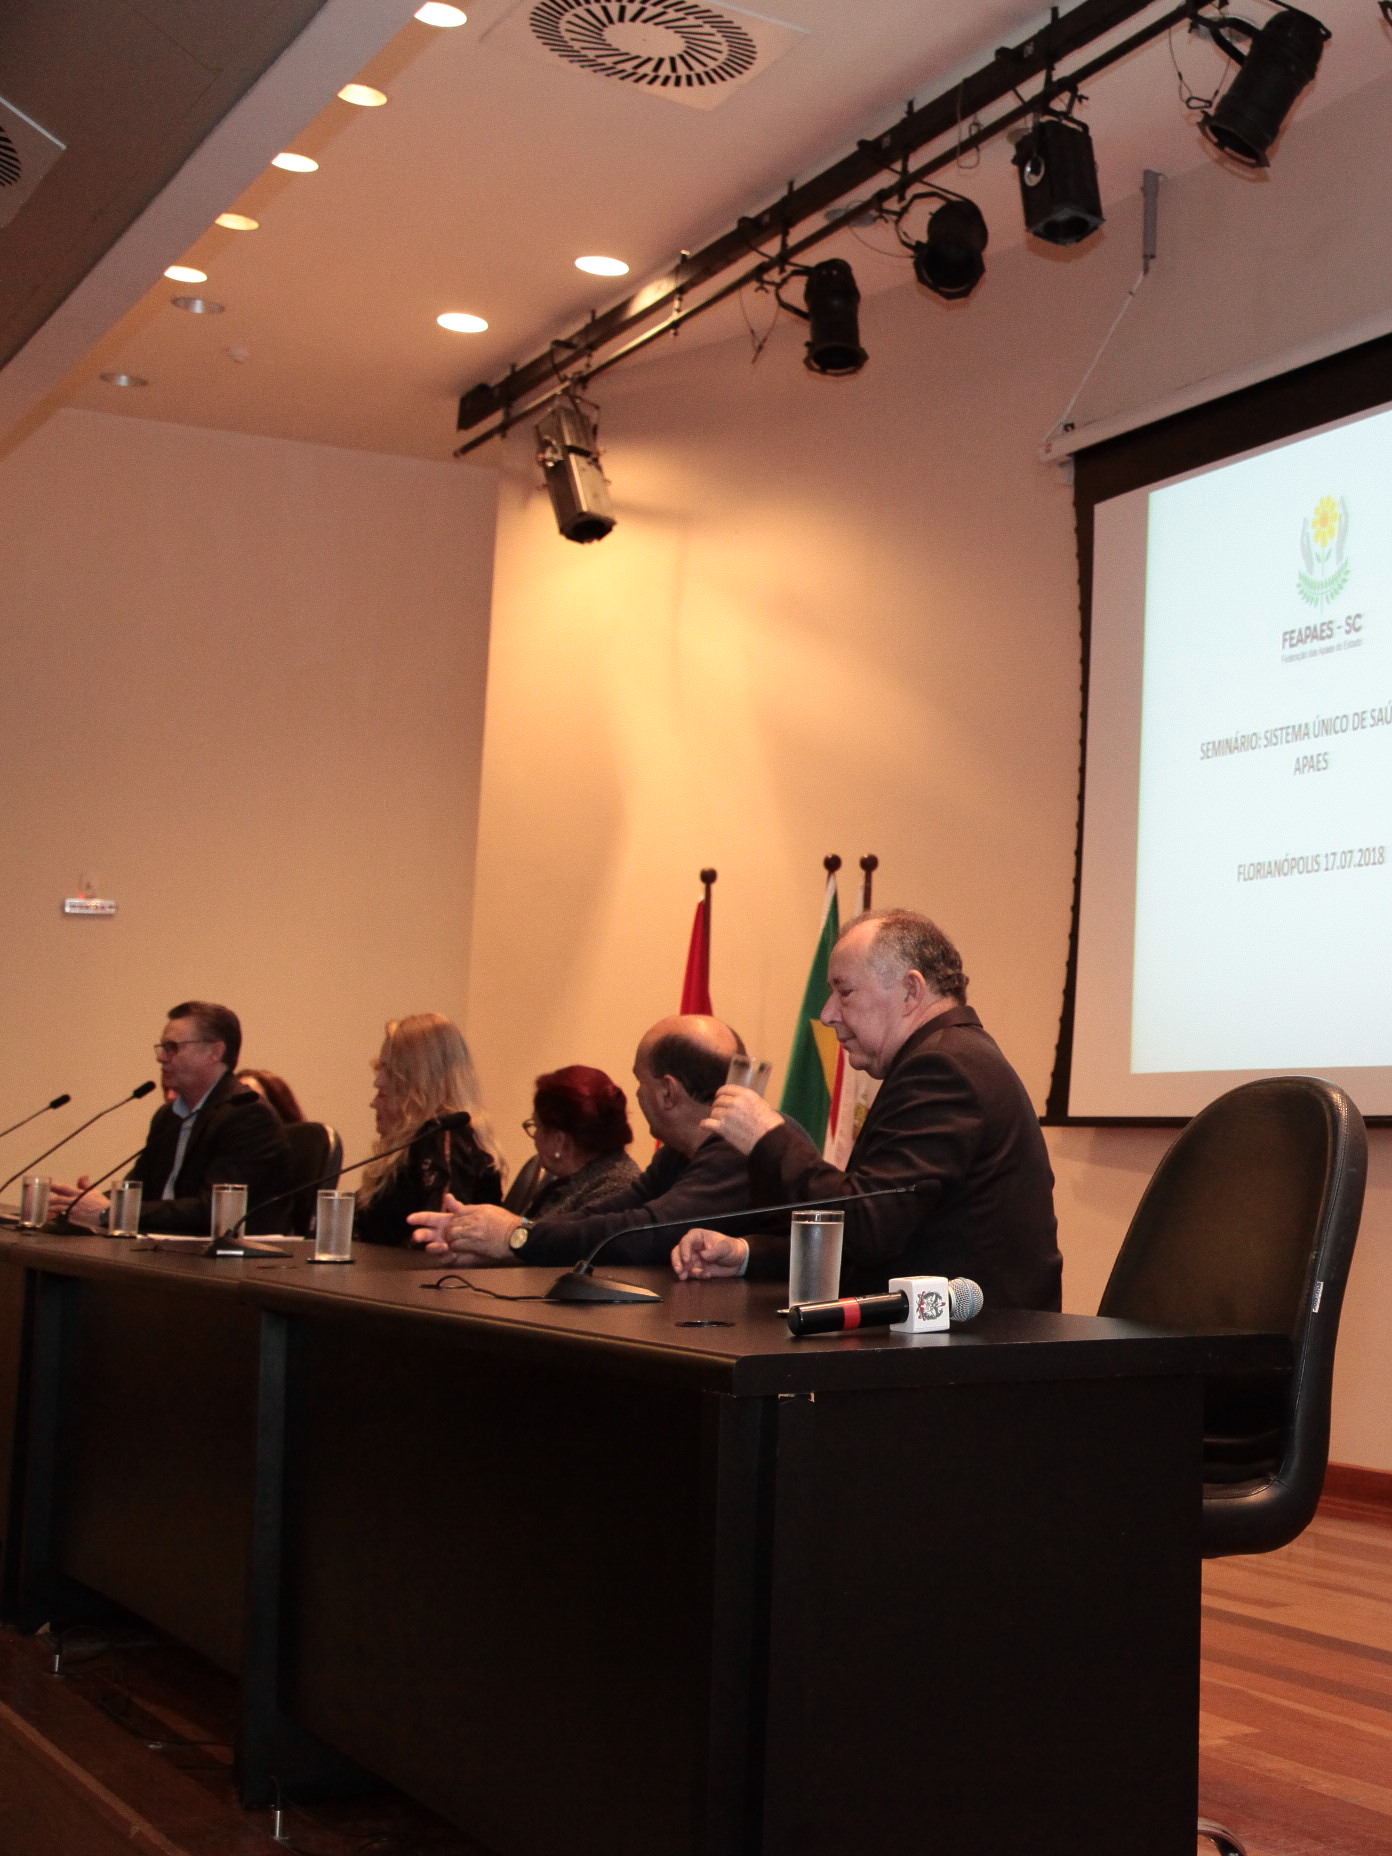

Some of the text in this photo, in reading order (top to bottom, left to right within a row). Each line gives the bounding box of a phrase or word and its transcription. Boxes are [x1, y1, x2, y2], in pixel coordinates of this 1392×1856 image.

[1282, 620, 1334, 650] FEAPAES
[1345, 613, 1362, 635] SC
[1200, 730, 1262, 761] SEMINÁRIO:
[1264, 722, 1310, 748] SISTEMA
[1313, 715, 1349, 738] ÚNICO
[1352, 710, 1368, 731] DE
[1293, 752, 1329, 776] APAES
[1237, 846, 1386, 882] FLORIANÓPOLIS 17.07.2018
